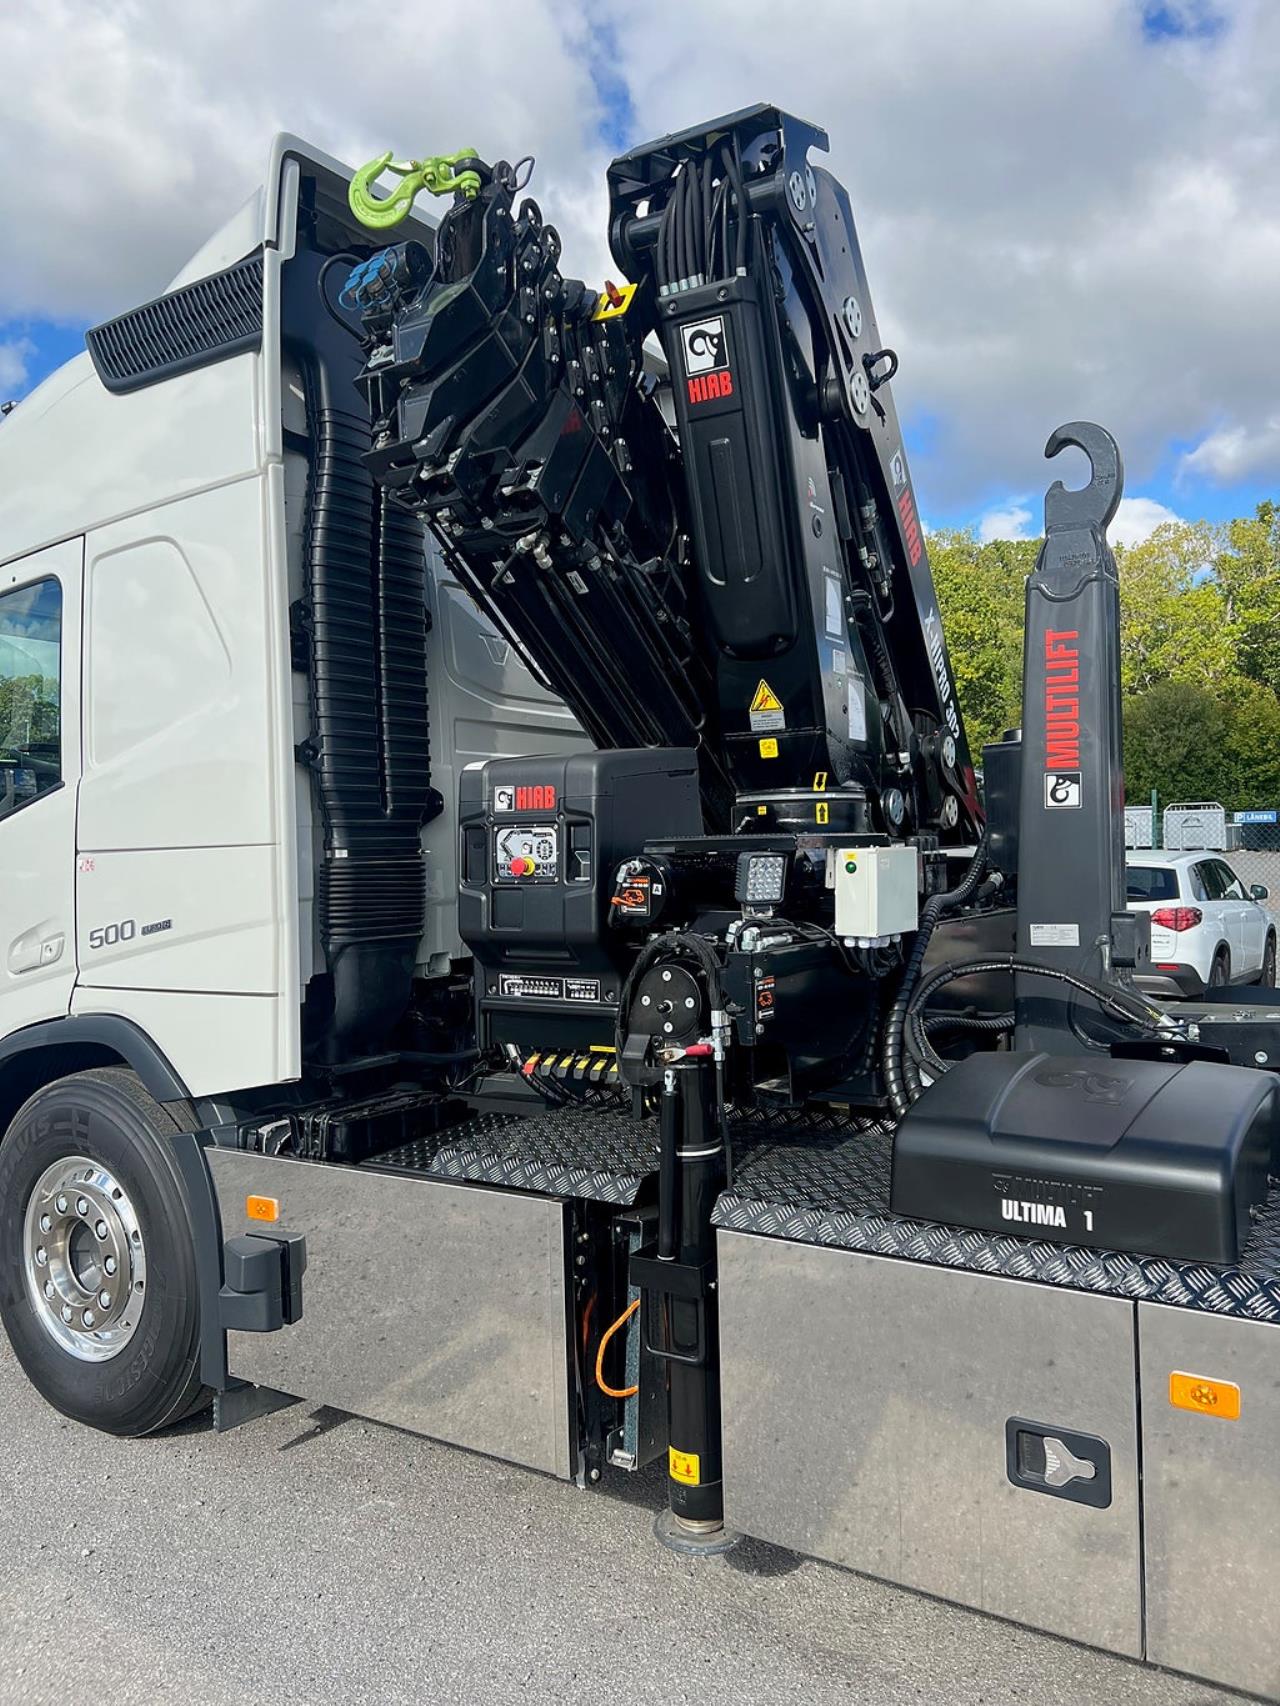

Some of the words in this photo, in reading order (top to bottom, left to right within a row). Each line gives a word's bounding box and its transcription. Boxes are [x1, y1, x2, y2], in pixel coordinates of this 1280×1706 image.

[688, 371, 732, 403] HIAB
[898, 488, 921, 567] HIAB
[925, 607, 950, 703] X-HIPRO
[1046, 629, 1080, 769] MULTILIFT
[516, 785, 555, 809] HIAB
[89, 919, 135, 949] 500
[1001, 1198, 1067, 1229] ULTIMA
[1083, 1210, 1093, 1232] 1
